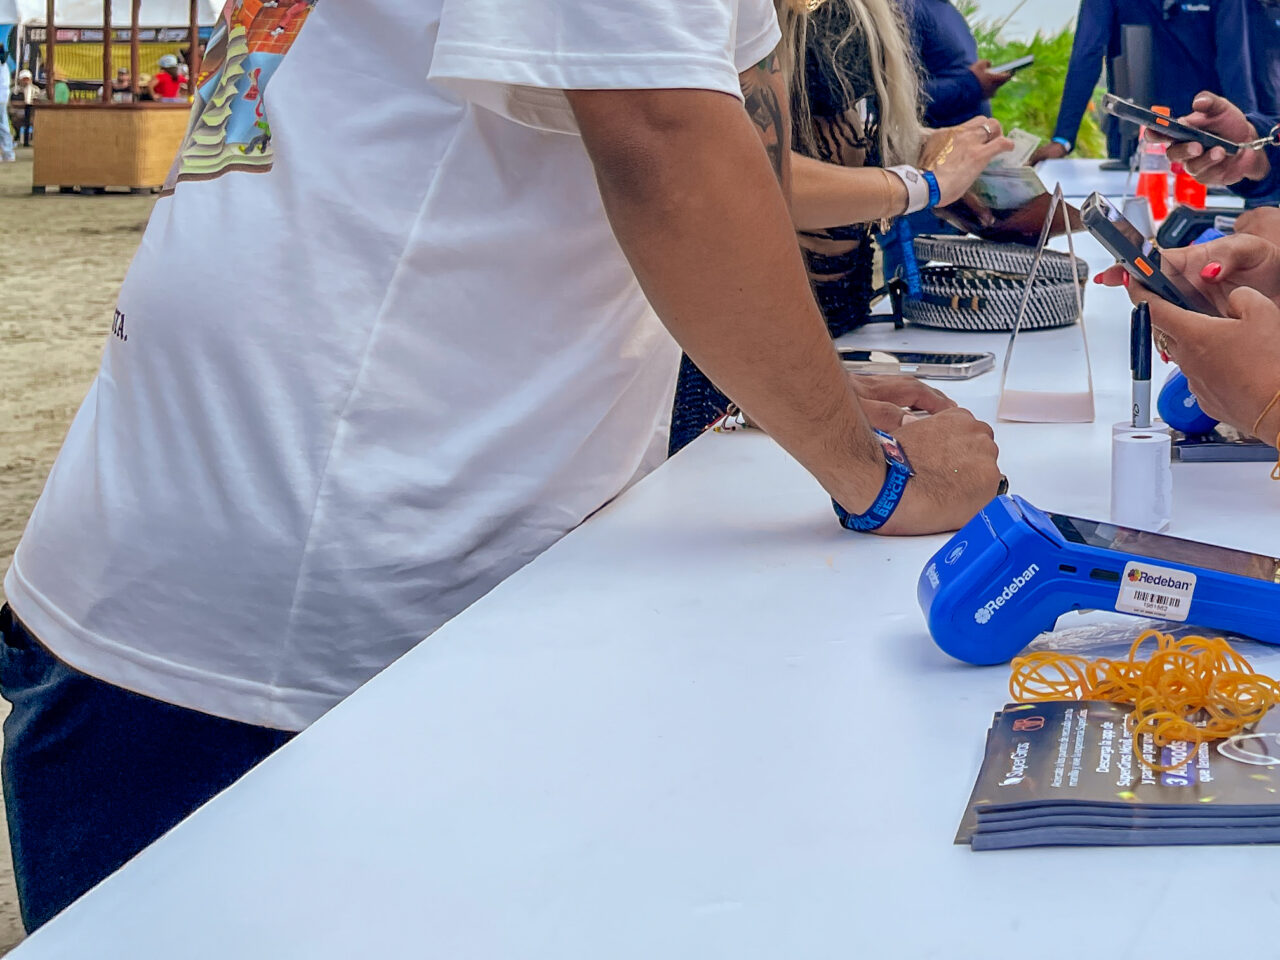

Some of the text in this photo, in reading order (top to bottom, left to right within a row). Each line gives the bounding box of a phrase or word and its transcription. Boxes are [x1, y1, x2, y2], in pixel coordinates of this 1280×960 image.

[878, 471, 907, 518] BEACH
[986, 562, 1040, 615] Redeban
[1139, 571, 1190, 591] Redeban
[1165, 777, 1189, 786] 3
